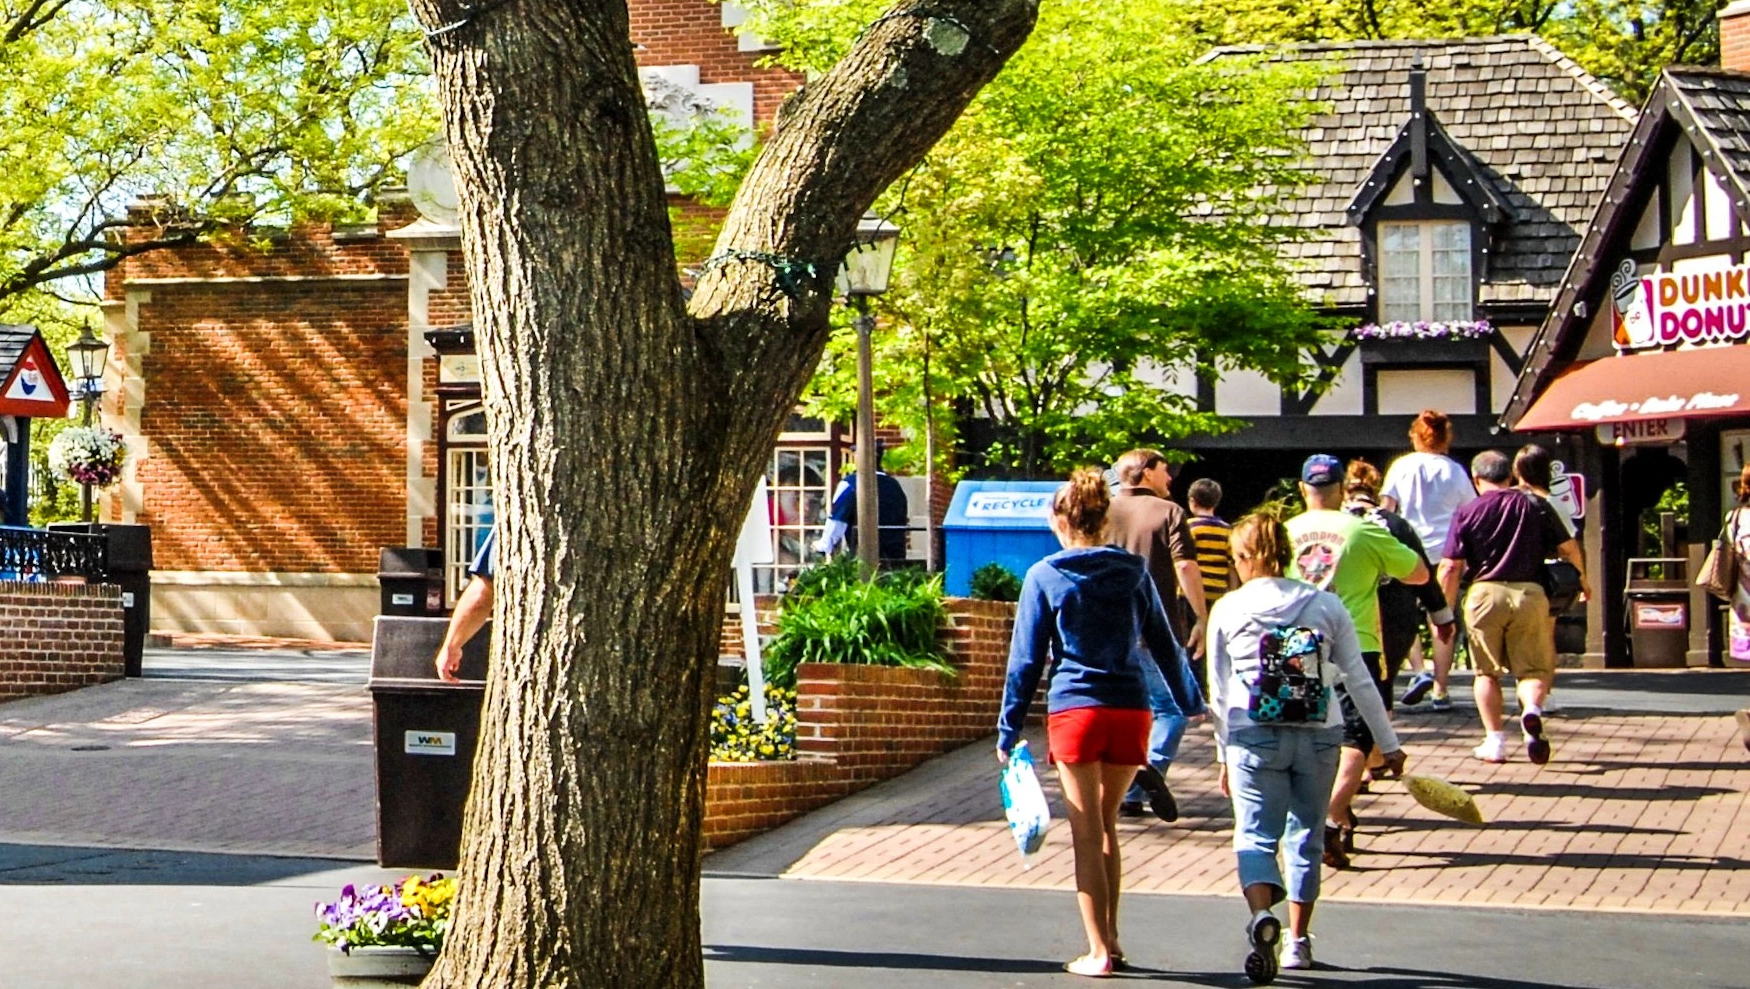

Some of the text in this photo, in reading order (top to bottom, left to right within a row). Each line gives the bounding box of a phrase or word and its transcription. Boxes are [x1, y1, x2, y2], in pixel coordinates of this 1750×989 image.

[1661, 303, 1750, 341] DONU
[1613, 419, 1668, 438] ENTER
[981, 497, 1046, 511] RECYCLE
[418, 736, 442, 745] WM
